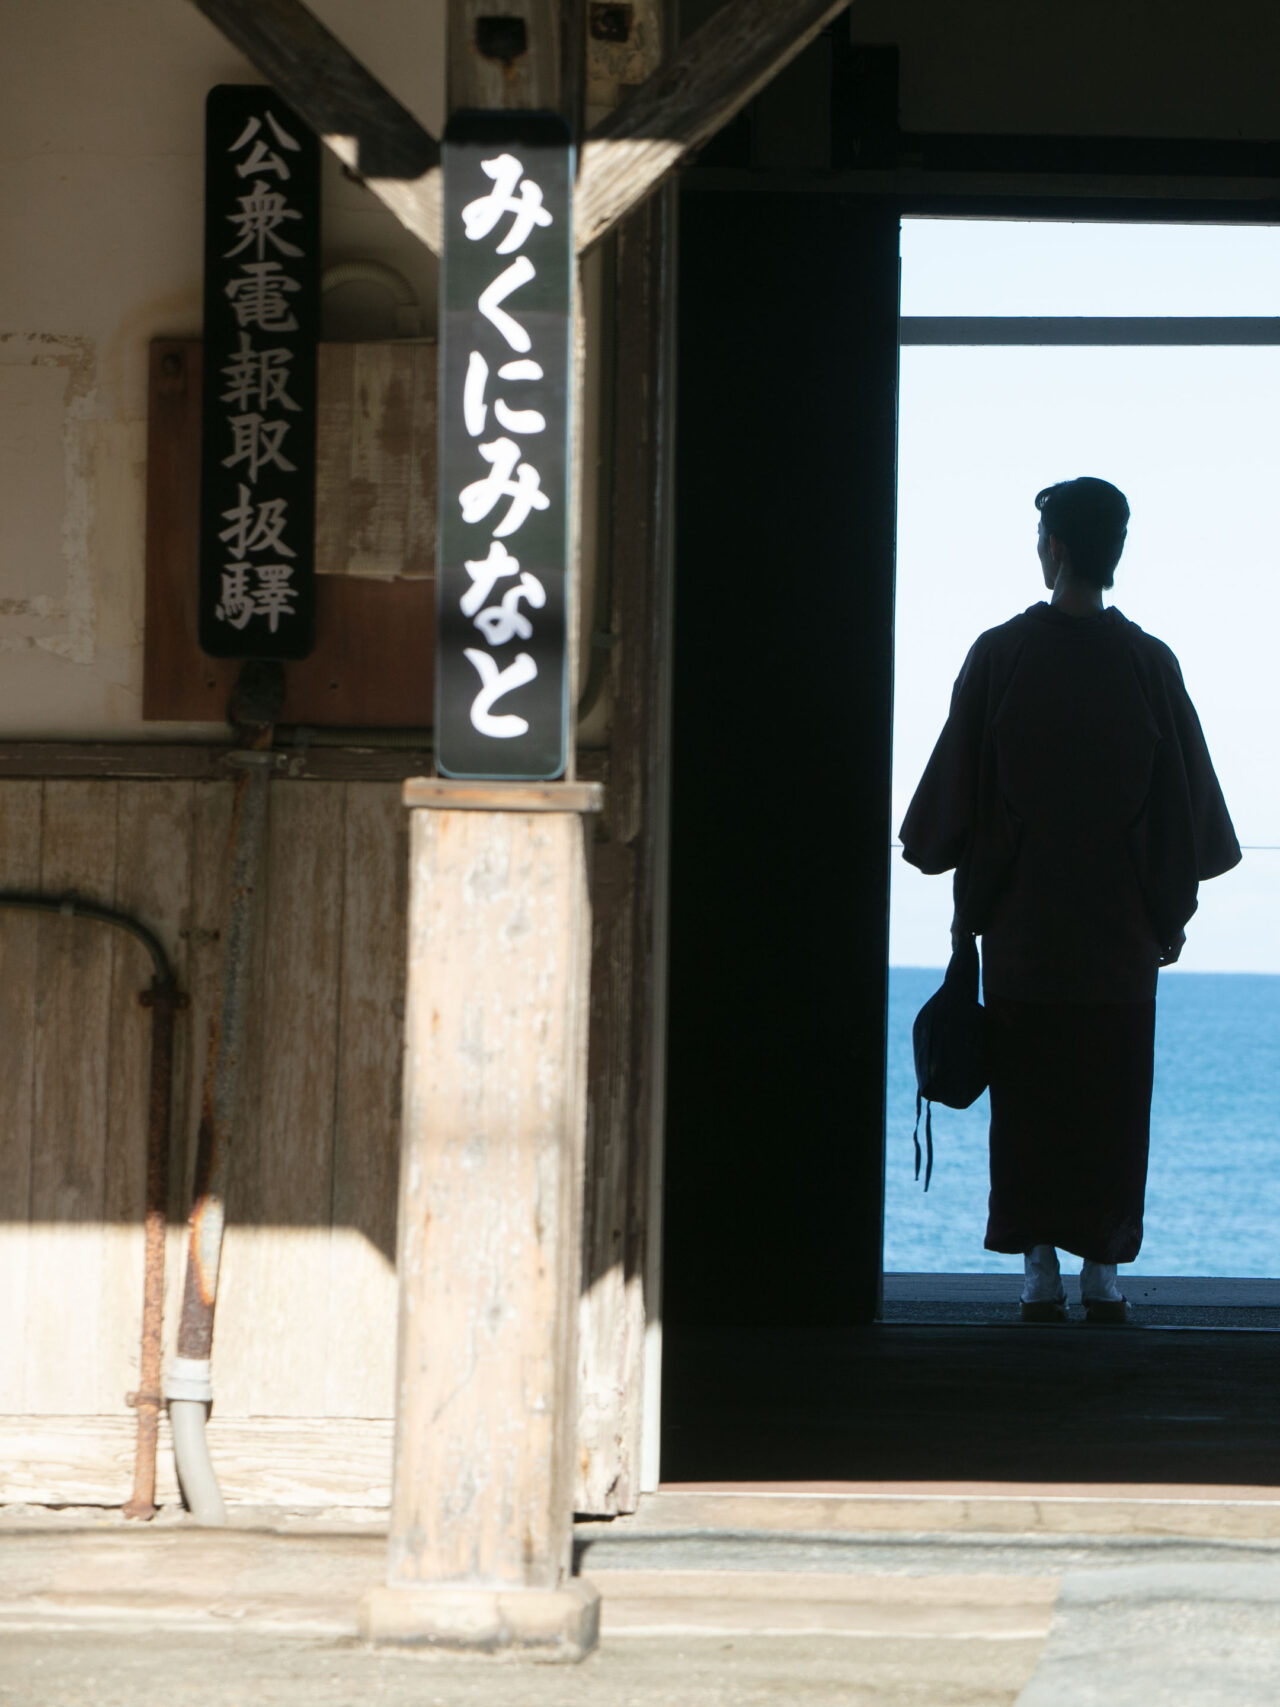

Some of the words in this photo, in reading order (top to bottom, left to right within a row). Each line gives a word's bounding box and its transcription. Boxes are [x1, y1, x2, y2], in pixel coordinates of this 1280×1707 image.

[216, 111, 304, 633] 公衆電報取扱驛
[459, 153, 553, 738] みくにみなと
